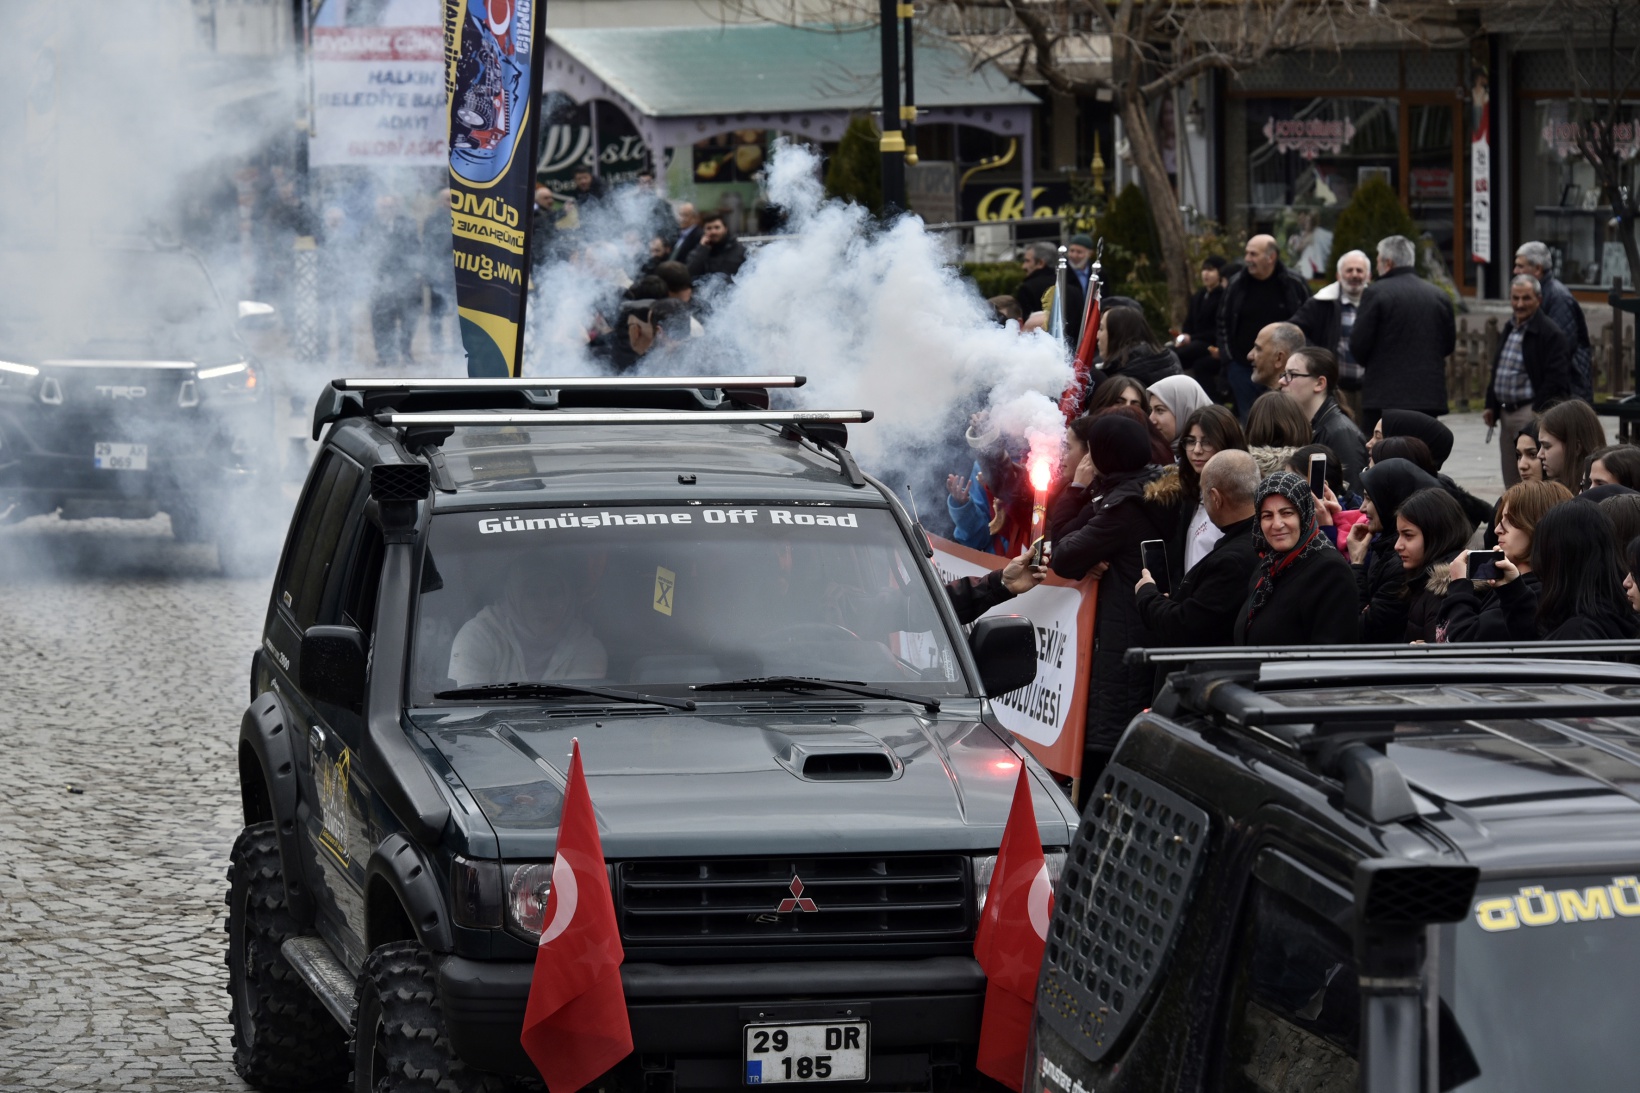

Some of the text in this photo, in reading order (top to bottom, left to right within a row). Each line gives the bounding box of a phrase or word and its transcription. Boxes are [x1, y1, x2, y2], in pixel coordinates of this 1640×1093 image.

[96, 443, 111, 456] 29
[478, 508, 859, 535] Gümüşhane Off Road
[752, 1026, 861, 1053] 29 DR
[781, 1055, 832, 1079] 185
